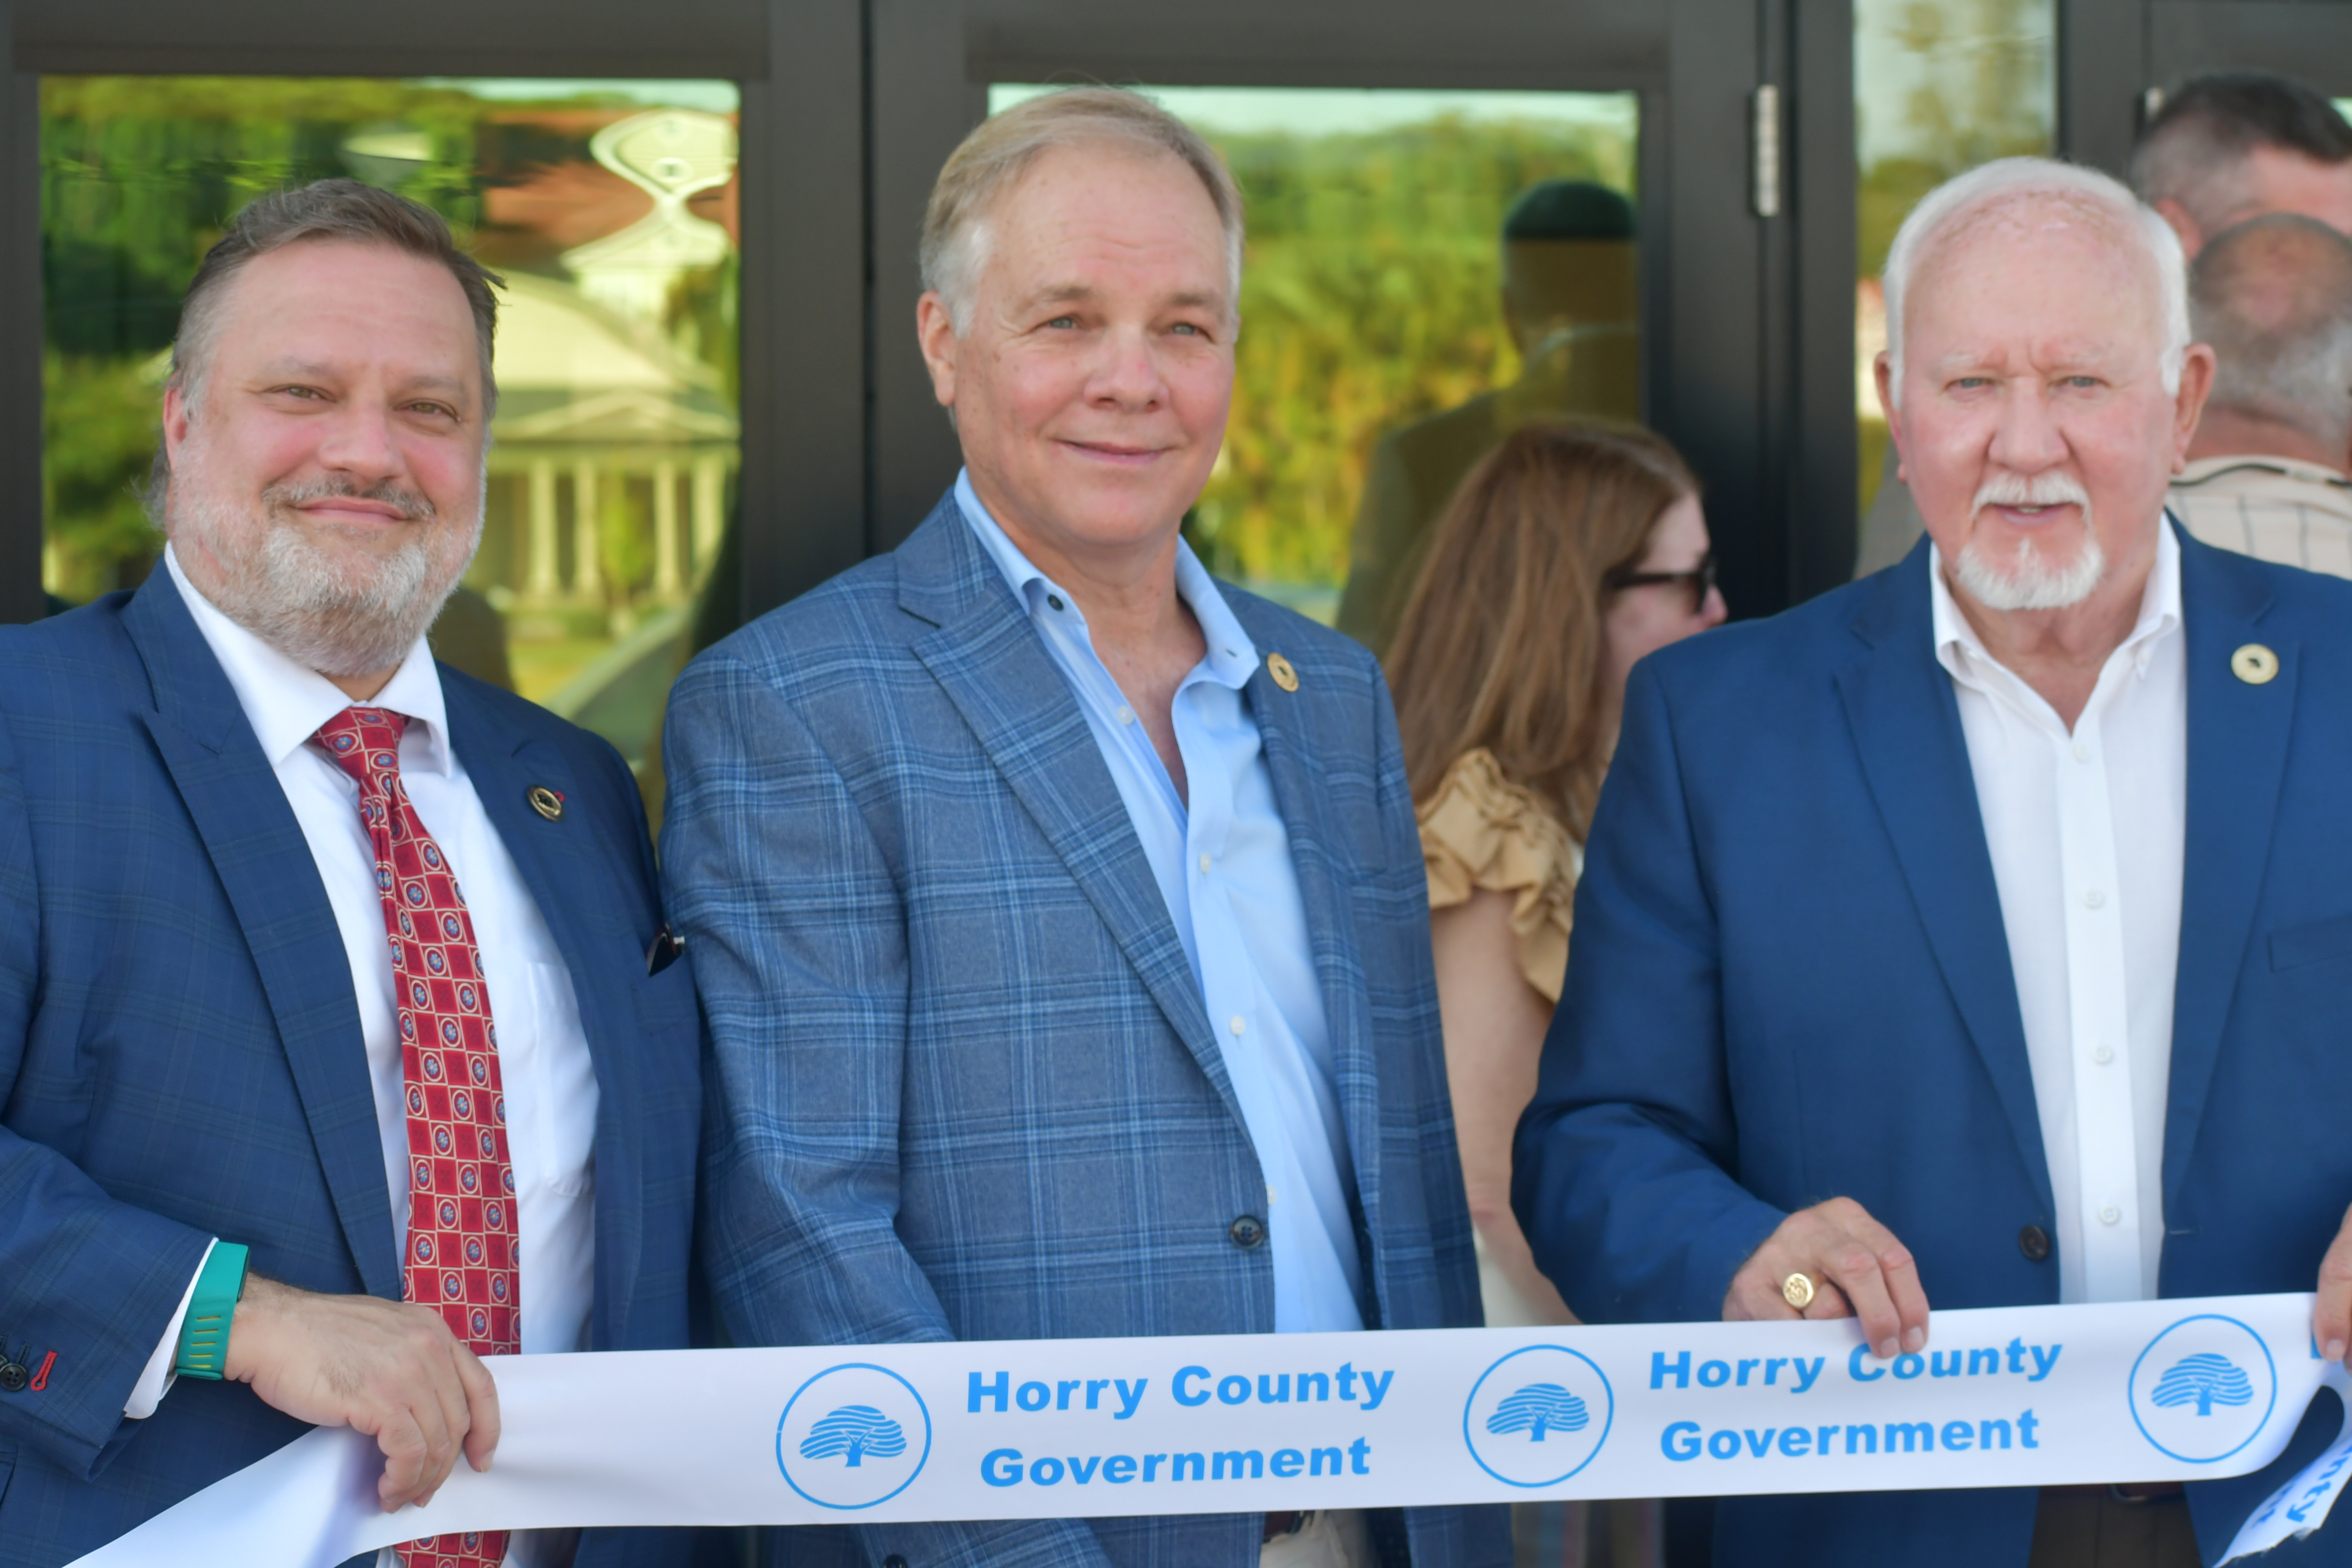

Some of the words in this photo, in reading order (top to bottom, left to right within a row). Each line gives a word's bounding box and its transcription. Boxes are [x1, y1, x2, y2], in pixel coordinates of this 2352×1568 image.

[967, 1371, 1149, 1420] Horry
[1171, 1361, 1395, 1411] County
[1650, 1350, 1826, 1394] Horry
[1848, 1337, 2063, 1383] County
[980, 1436, 1372, 1488] Government
[1660, 1409, 2040, 1462] Government
